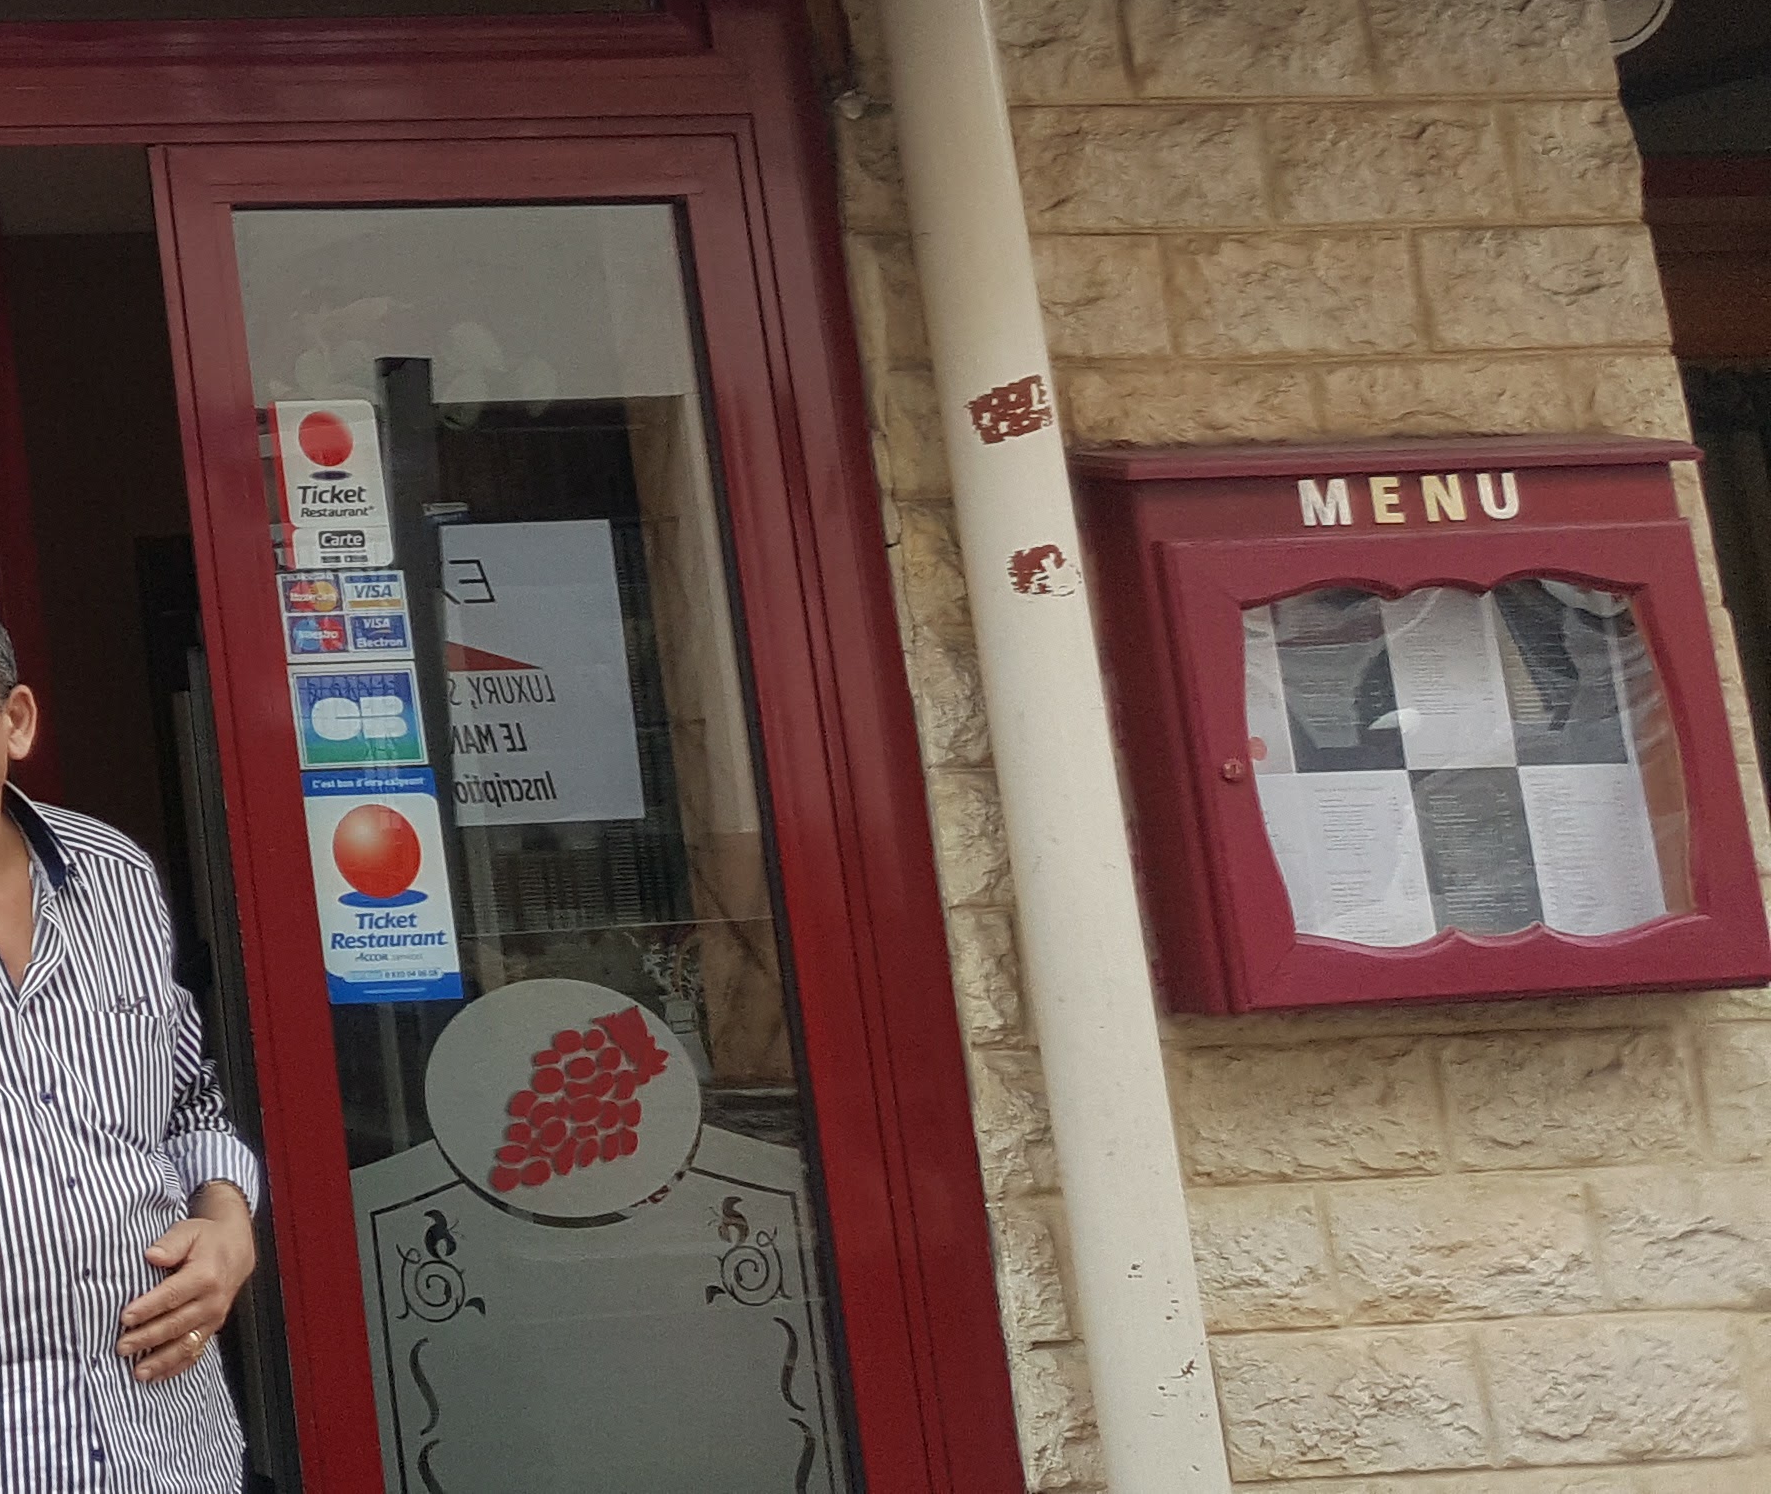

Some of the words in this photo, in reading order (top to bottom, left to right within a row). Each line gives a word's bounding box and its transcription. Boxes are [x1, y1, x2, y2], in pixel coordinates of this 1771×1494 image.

[298, 485, 367, 505] Ticket
[1297, 472, 1520, 527] MENU
[320, 533, 364, 547] Carte
[355, 585, 393, 599] VISA
[362, 617, 391, 629] VISA
[356, 637, 404, 649] Electron
[355, 911, 419, 931] Ticket
[330, 930, 449, 950] Restaurant
